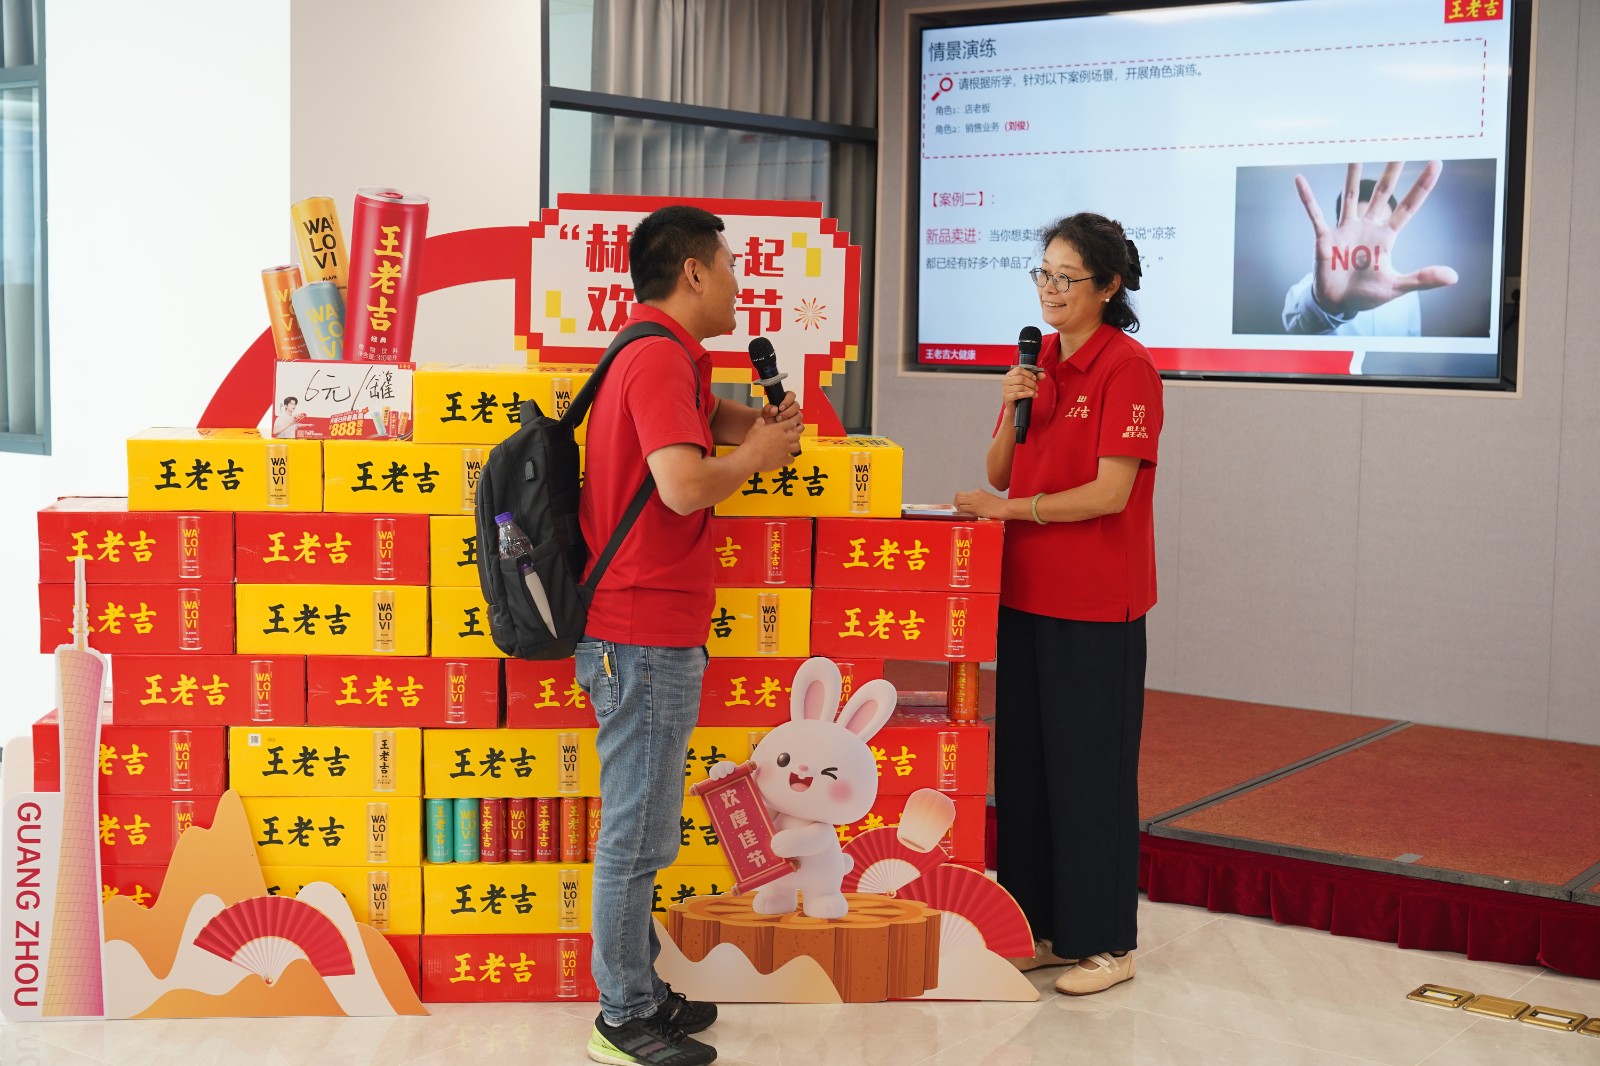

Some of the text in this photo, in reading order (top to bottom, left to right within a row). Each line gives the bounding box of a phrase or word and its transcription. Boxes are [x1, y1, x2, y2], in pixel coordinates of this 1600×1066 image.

[1448, 0, 1500, 19] 王老吉
[928, 38, 997, 62] 情景演练
[958, 63, 1202, 90] 请根据所学，针对以下案例场景，开展角色演练。
[302, 216, 333, 237] WA
[308, 232, 337, 255] LO
[313, 250, 338, 270] VI
[1331, 246, 1381, 271] NO!
[366, 224, 404, 332] 王老吉
[305, 303, 339, 324] WA
[315, 321, 343, 342] LO
[926, 349, 976, 361] 王老吉大健康
[555, 390, 571, 400] WA
[439, 391, 523, 424] 王老吉
[270, 457, 286, 466] WA
[466, 461, 481, 470] WA
[272, 466, 286, 476] LO
[854, 464, 869, 473] WA
[154, 458, 244, 491] 王老吉
[350, 460, 440, 494] 王老吉
[855, 473, 869, 485] LO
[272, 476, 284, 485] VI
[855, 482, 867, 492] VI
[182, 528, 198, 539] WA
[378, 531, 393, 541] WA
[66, 529, 157, 563] 王老吉
[183, 537, 199, 547] LO
[379, 539, 394, 550] LO
[955, 539, 970, 548] WA
[183, 547, 197, 557] VI
[262, 531, 352, 564] 王老吉
[770, 531, 781, 566] 王老吉
[379, 549, 391, 559] VI
[843, 537, 930, 571] 王老吉
[955, 548, 970, 558] LO
[956, 557, 968, 566] VI
[182, 600, 199, 610] WA
[377, 603, 392, 612] WA
[761, 605, 777, 615] WA
[183, 609, 199, 620] LO
[378, 612, 393, 621] LO
[950, 609, 965, 619] WA
[184, 619, 197, 629] VI
[262, 603, 351, 636] 王老吉
[763, 614, 777, 626] LO
[838, 607, 925, 641] 王老吉
[951, 618, 966, 628] LO
[378, 621, 390, 630] VI
[763, 623, 774, 633] VI
[951, 627, 963, 636] VI
[255, 673, 271, 682] WA
[449, 675, 465, 685] WA
[140, 673, 229, 706] 王老吉
[256, 681, 271, 691] LO
[335, 674, 424, 708] 王老吉
[450, 684, 465, 694] LO
[257, 691, 269, 701] VI
[724, 676, 792, 708] 王老
[451, 693, 463, 703] VI
[174, 742, 190, 752] WA
[562, 745, 577, 754] WA
[941, 744, 957, 753] WA
[175, 751, 190, 761] LO
[261, 745, 350, 777] 王老吉
[379, 739, 390, 774] 王老吉
[563, 754, 577, 763] LO
[943, 753, 957, 762] LO
[175, 761, 188, 770] VI
[449, 747, 537, 779] 王老吉
[563, 763, 575, 772] VI
[943, 762, 954, 771] VI
[176, 812, 192, 822] WA
[371, 815, 386, 824] WA
[460, 810, 476, 819] WA
[510, 810, 526, 820] WA
[372, 824, 386, 833] LO
[434, 806, 447, 846] 王老吉
[461, 820, 477, 829] LO
[482, 806, 494, 848] 王老吉
[511, 820, 526, 829] LO
[538, 806, 550, 848] 王老吉
[568, 806, 580, 845] 王老吉
[719, 788, 768, 868] 欢度佳节
[257, 815, 345, 847] 王老吉
[511, 829, 524, 840] VI
[372, 833, 384, 842] VI
[372, 883, 387, 892] WA
[562, 881, 577, 891] WA
[373, 892, 387, 901] LO
[450, 883, 537, 915] 王老吉
[563, 890, 577, 900] LO
[14, 802, 42, 1007] GUANG ZHOU
[373, 901, 385, 910] VI
[564, 899, 575, 908] VI
[561, 950, 576, 959] WA
[449, 952, 536, 984] 王老吉
[561, 959, 577, 968] LO
[563, 968, 574, 977] VI
